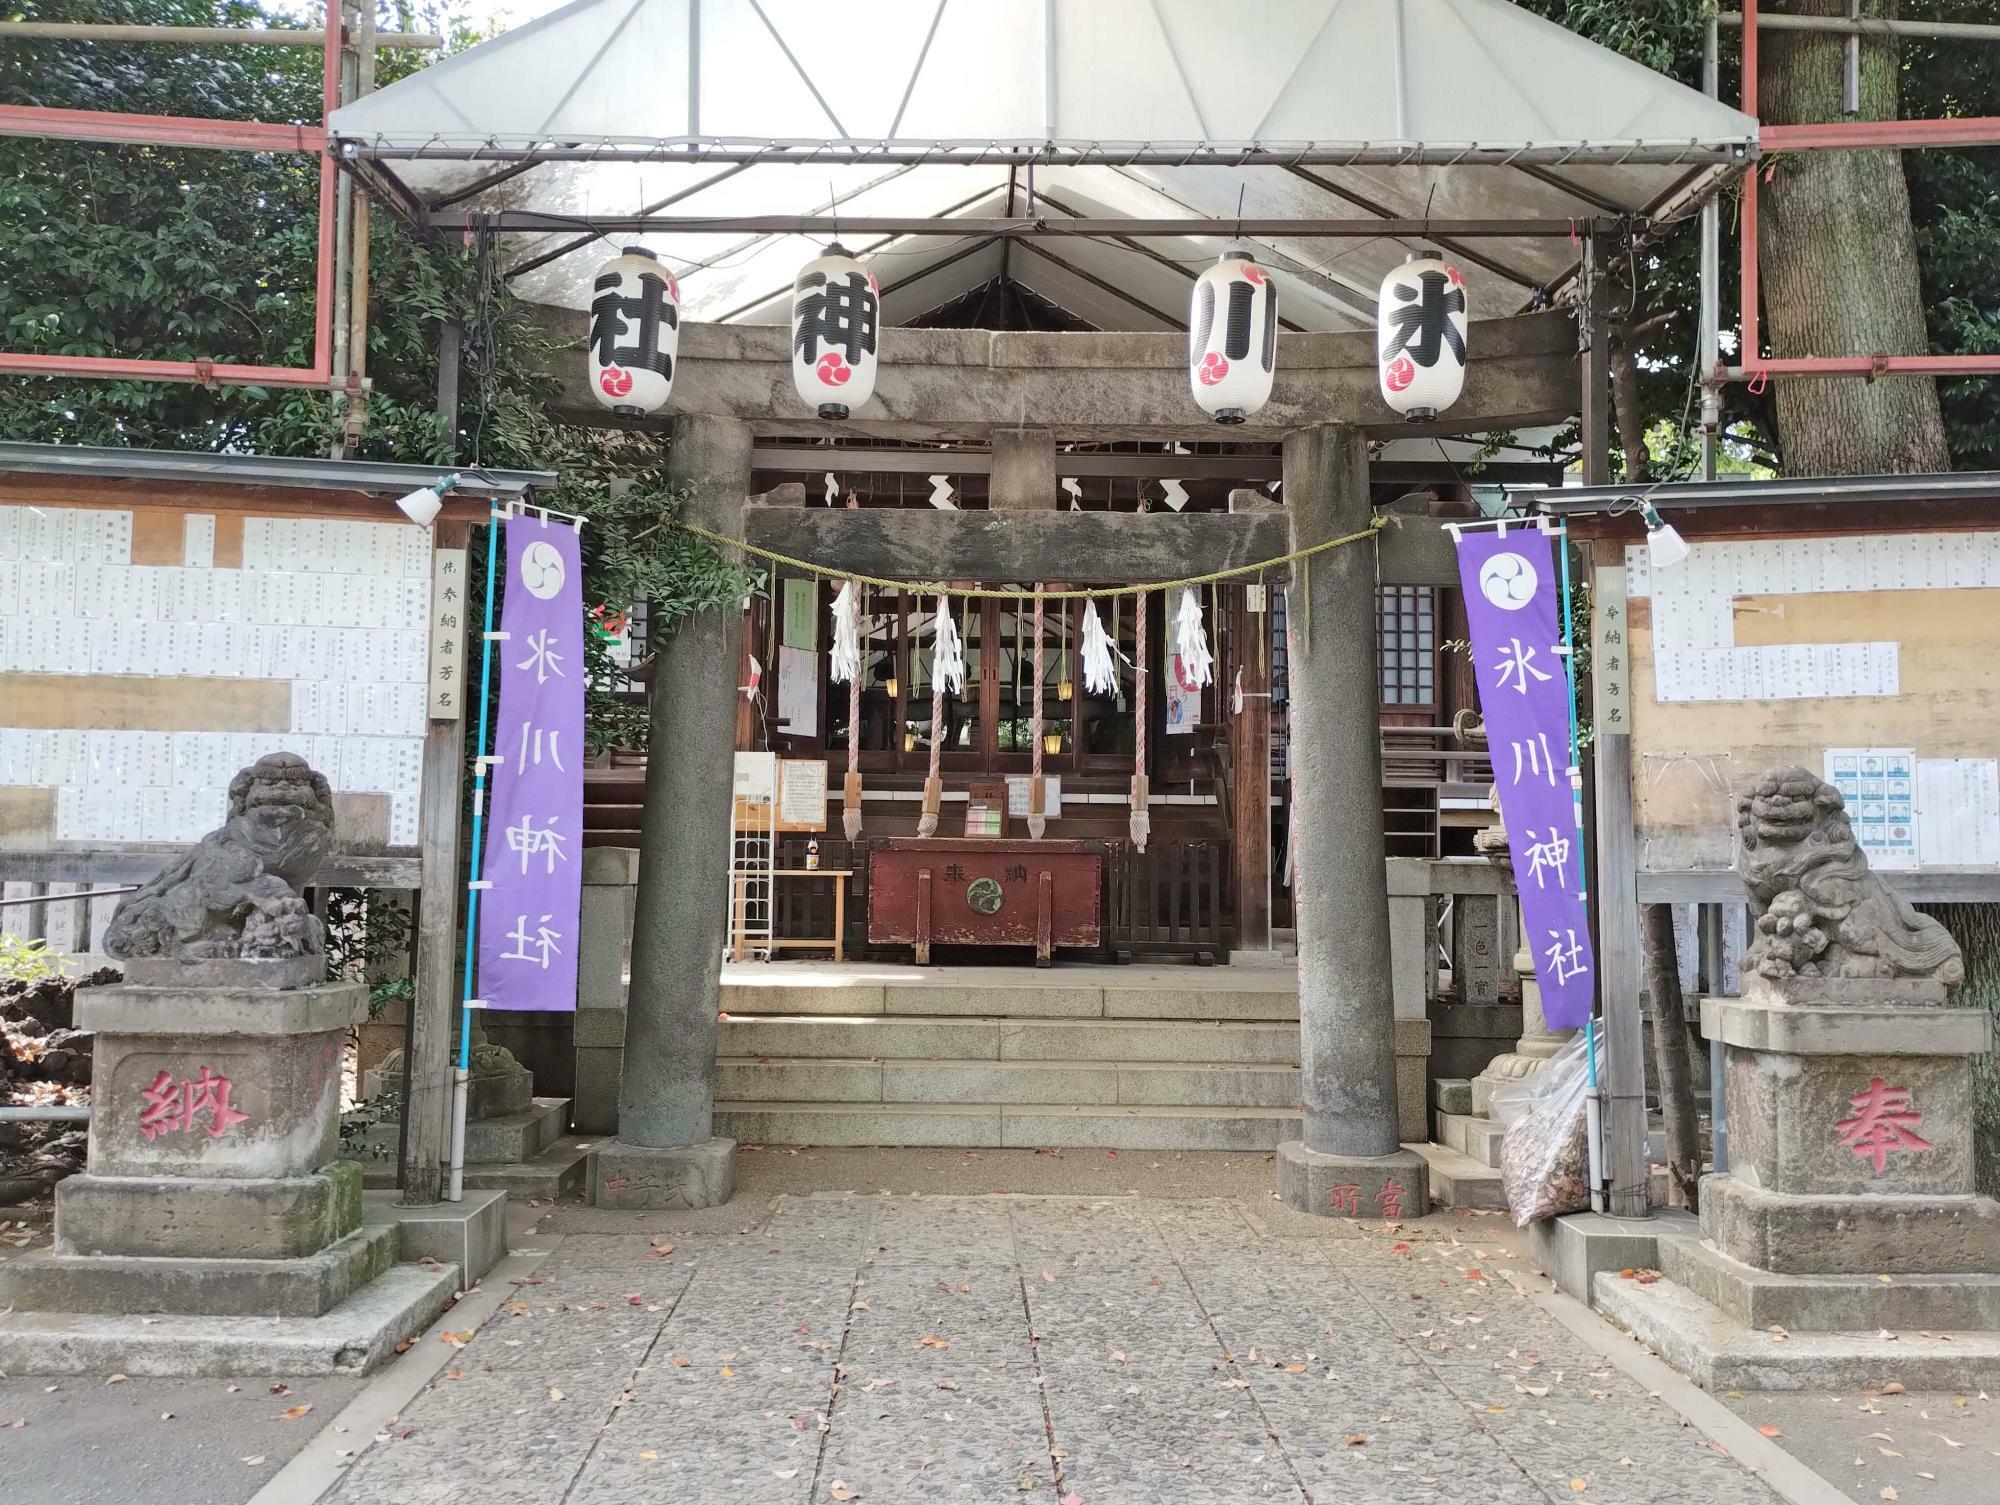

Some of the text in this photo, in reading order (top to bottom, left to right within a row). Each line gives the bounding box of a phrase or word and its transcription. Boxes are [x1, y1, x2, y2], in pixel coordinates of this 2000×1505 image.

[588, 271, 678, 382] 社
[794, 271, 879, 366] 神
[1191, 277, 1277, 374] 川
[1382, 269, 1466, 368] 氷
[1493, 637, 1588, 987] 氷川神社
[139, 1065, 251, 1142] 納
[1835, 1077, 1933, 1175] 奉
